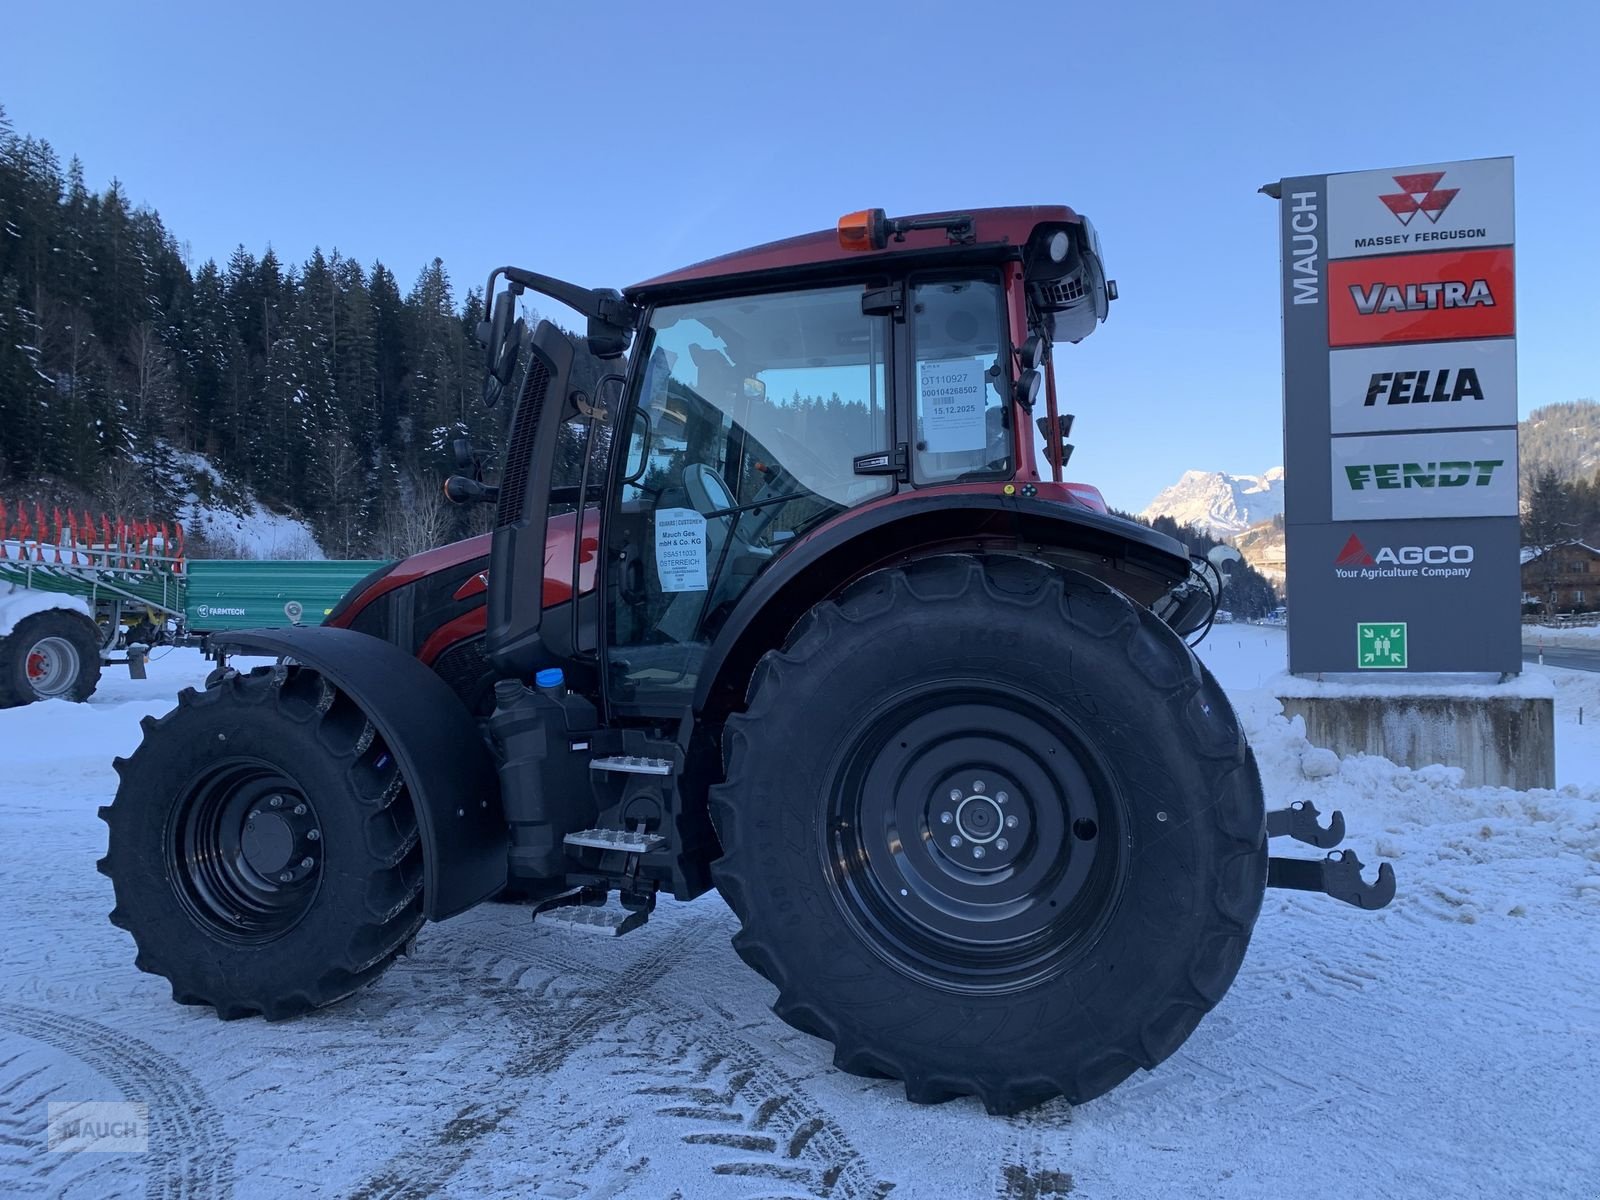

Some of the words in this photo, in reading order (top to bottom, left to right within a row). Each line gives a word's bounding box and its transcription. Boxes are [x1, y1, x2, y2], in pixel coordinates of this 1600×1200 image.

[1292, 191, 1319, 305] MAUCH
[1354, 234, 1410, 248] MASSEY
[1414, 228, 1486, 242] FERGUSON
[1348, 279, 1496, 315] VALTRA
[1363, 367, 1485, 407] FELLA
[934, 405, 976, 415] 15.12.2025
[1344, 459, 1504, 490] FENDT
[691, 537, 702, 545] KG
[1375, 545, 1474, 565] AGCO
[1336, 568, 1358, 578] Your
[1360, 567, 1419, 580] Agriculture
[1421, 566, 1472, 579] Company
[209, 607, 245, 616] FARMTECH
